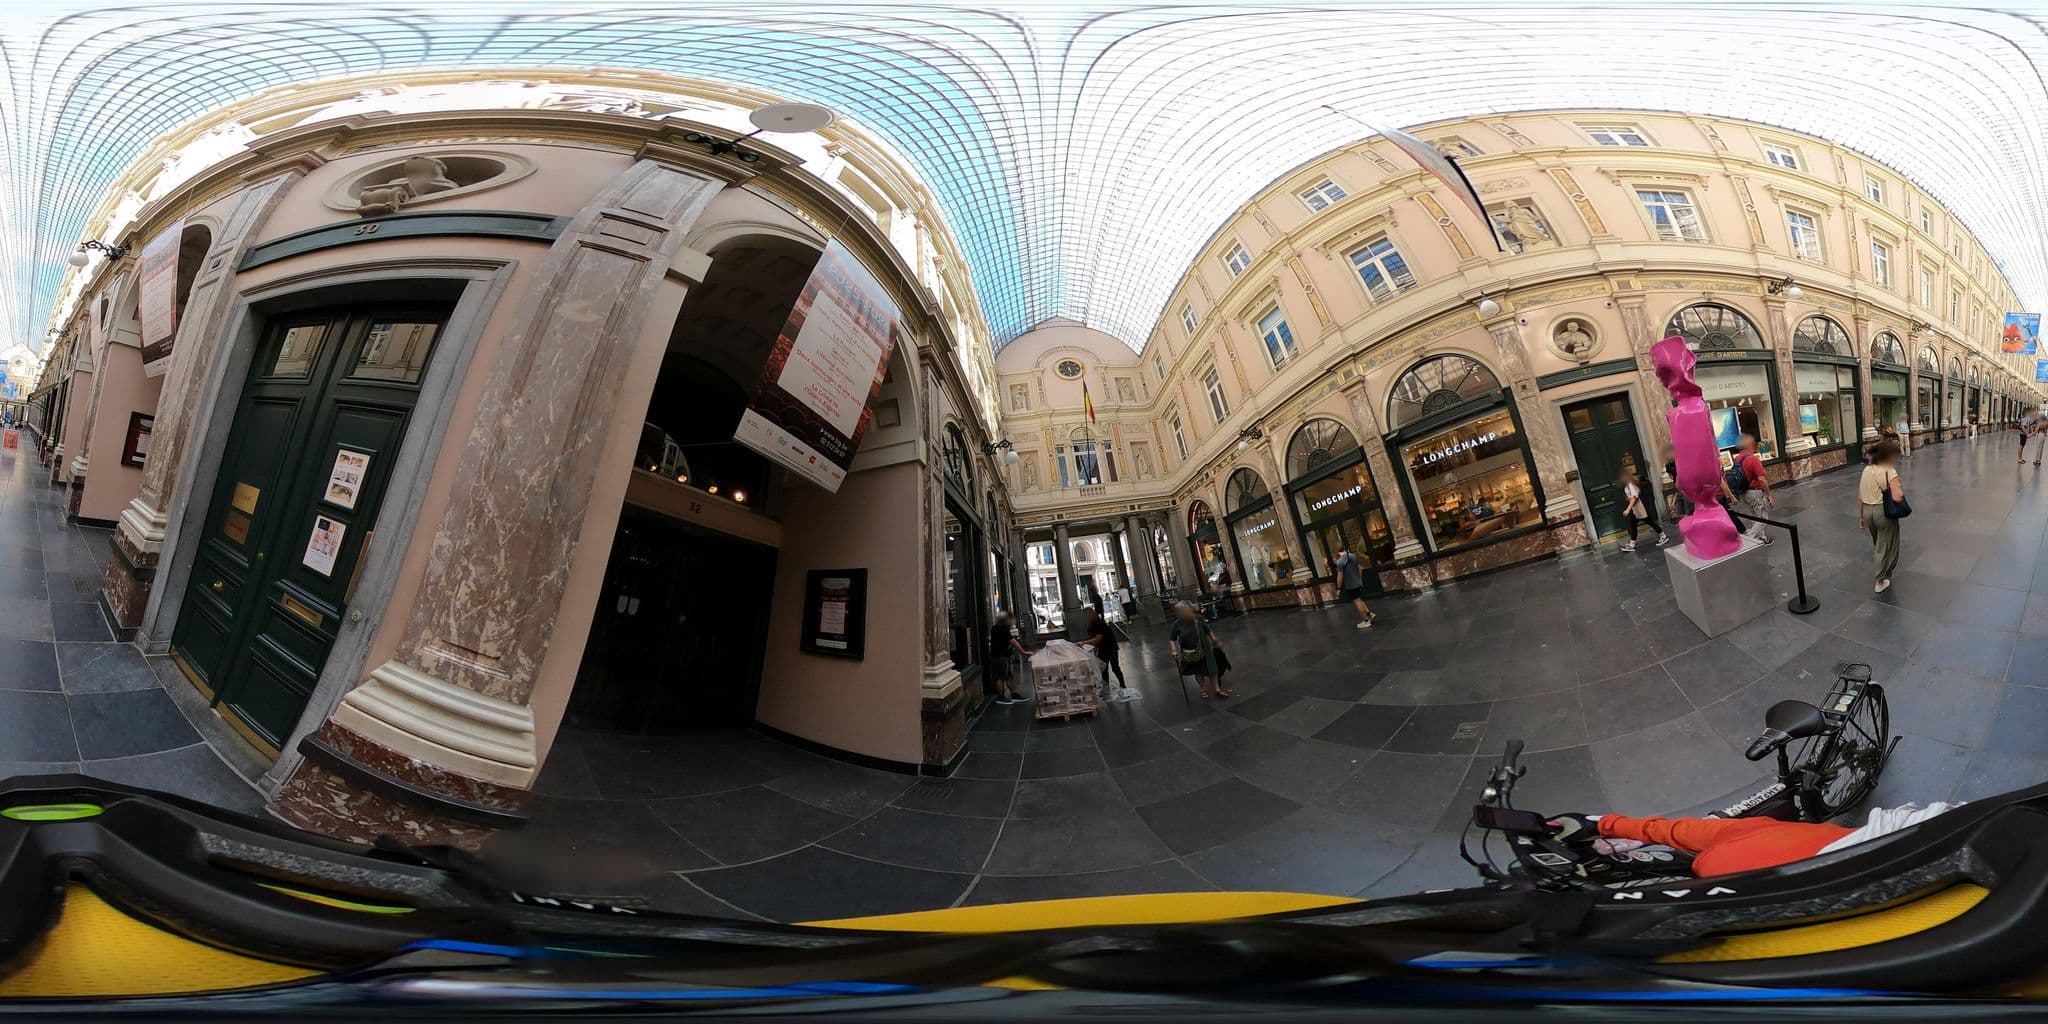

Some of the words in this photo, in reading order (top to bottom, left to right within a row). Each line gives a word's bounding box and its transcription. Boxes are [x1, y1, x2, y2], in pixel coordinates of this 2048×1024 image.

[1423, 432, 1498, 465] LONGCHAMP
[688, 502, 702, 513] 32
[1312, 485, 1363, 511] LONGCHAMP
[1243, 519, 1276, 537] LONGCHAMP
[1744, 784, 1781, 808] AMPAIGN
